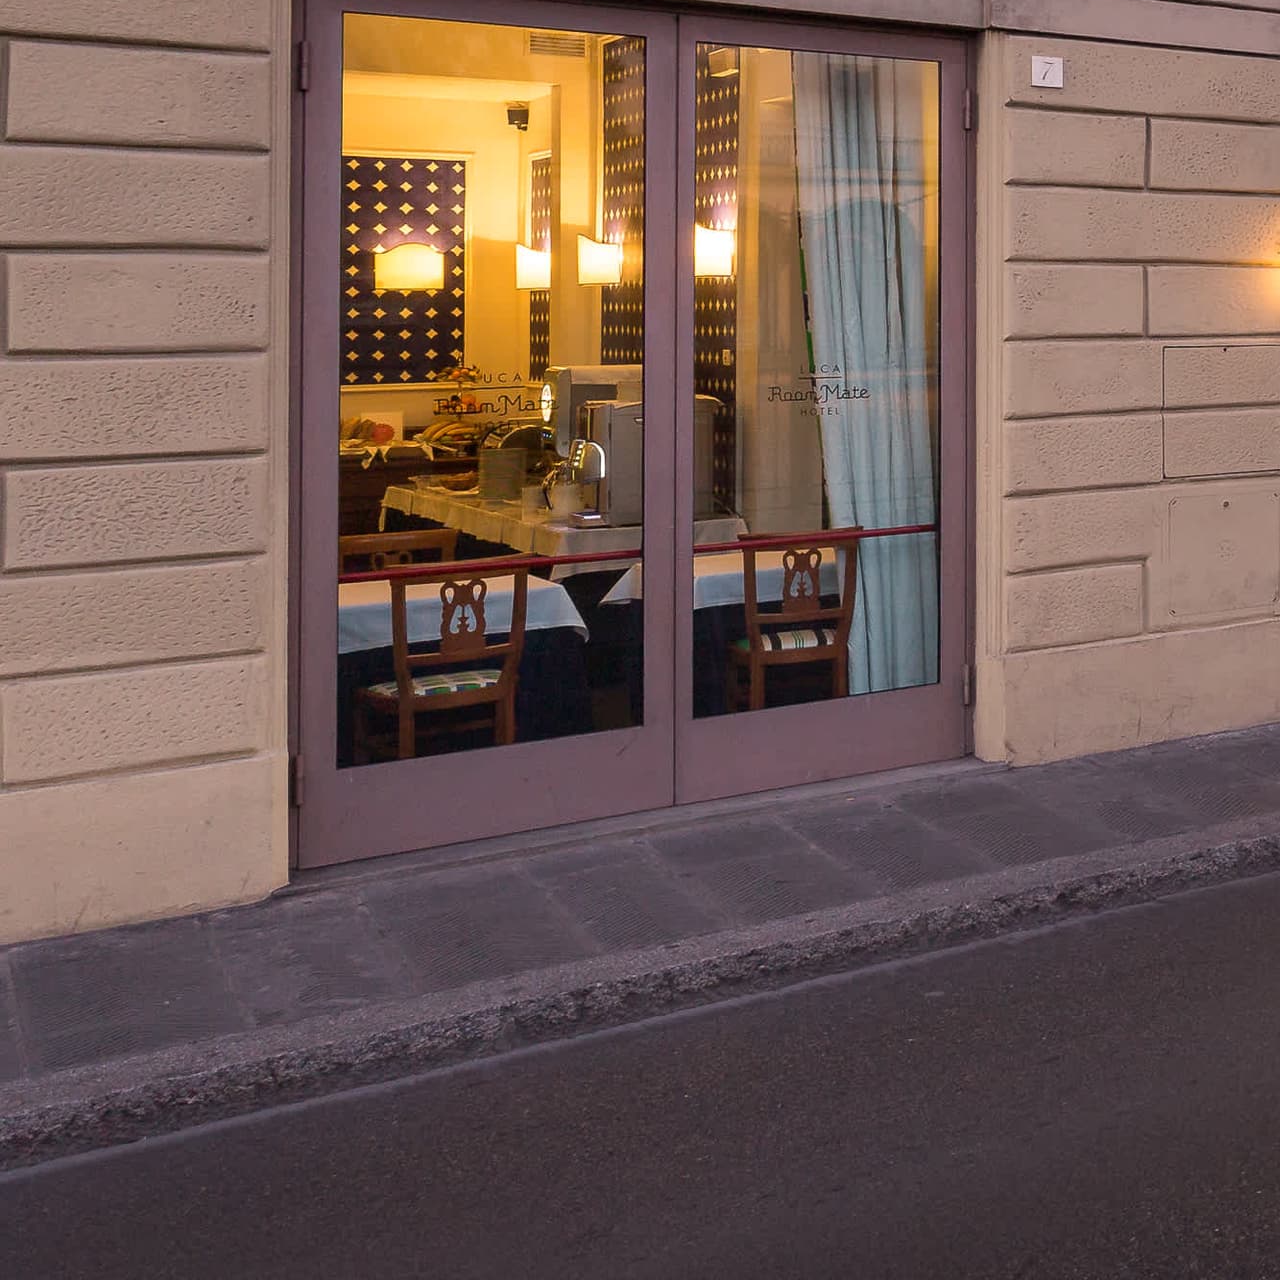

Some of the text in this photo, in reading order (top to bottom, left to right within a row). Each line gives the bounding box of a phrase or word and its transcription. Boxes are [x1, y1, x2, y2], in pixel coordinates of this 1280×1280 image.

[1043, 61, 1054, 81] 7
[483, 372, 522, 384] UCA
[800, 407, 840, 416] HOTEL
